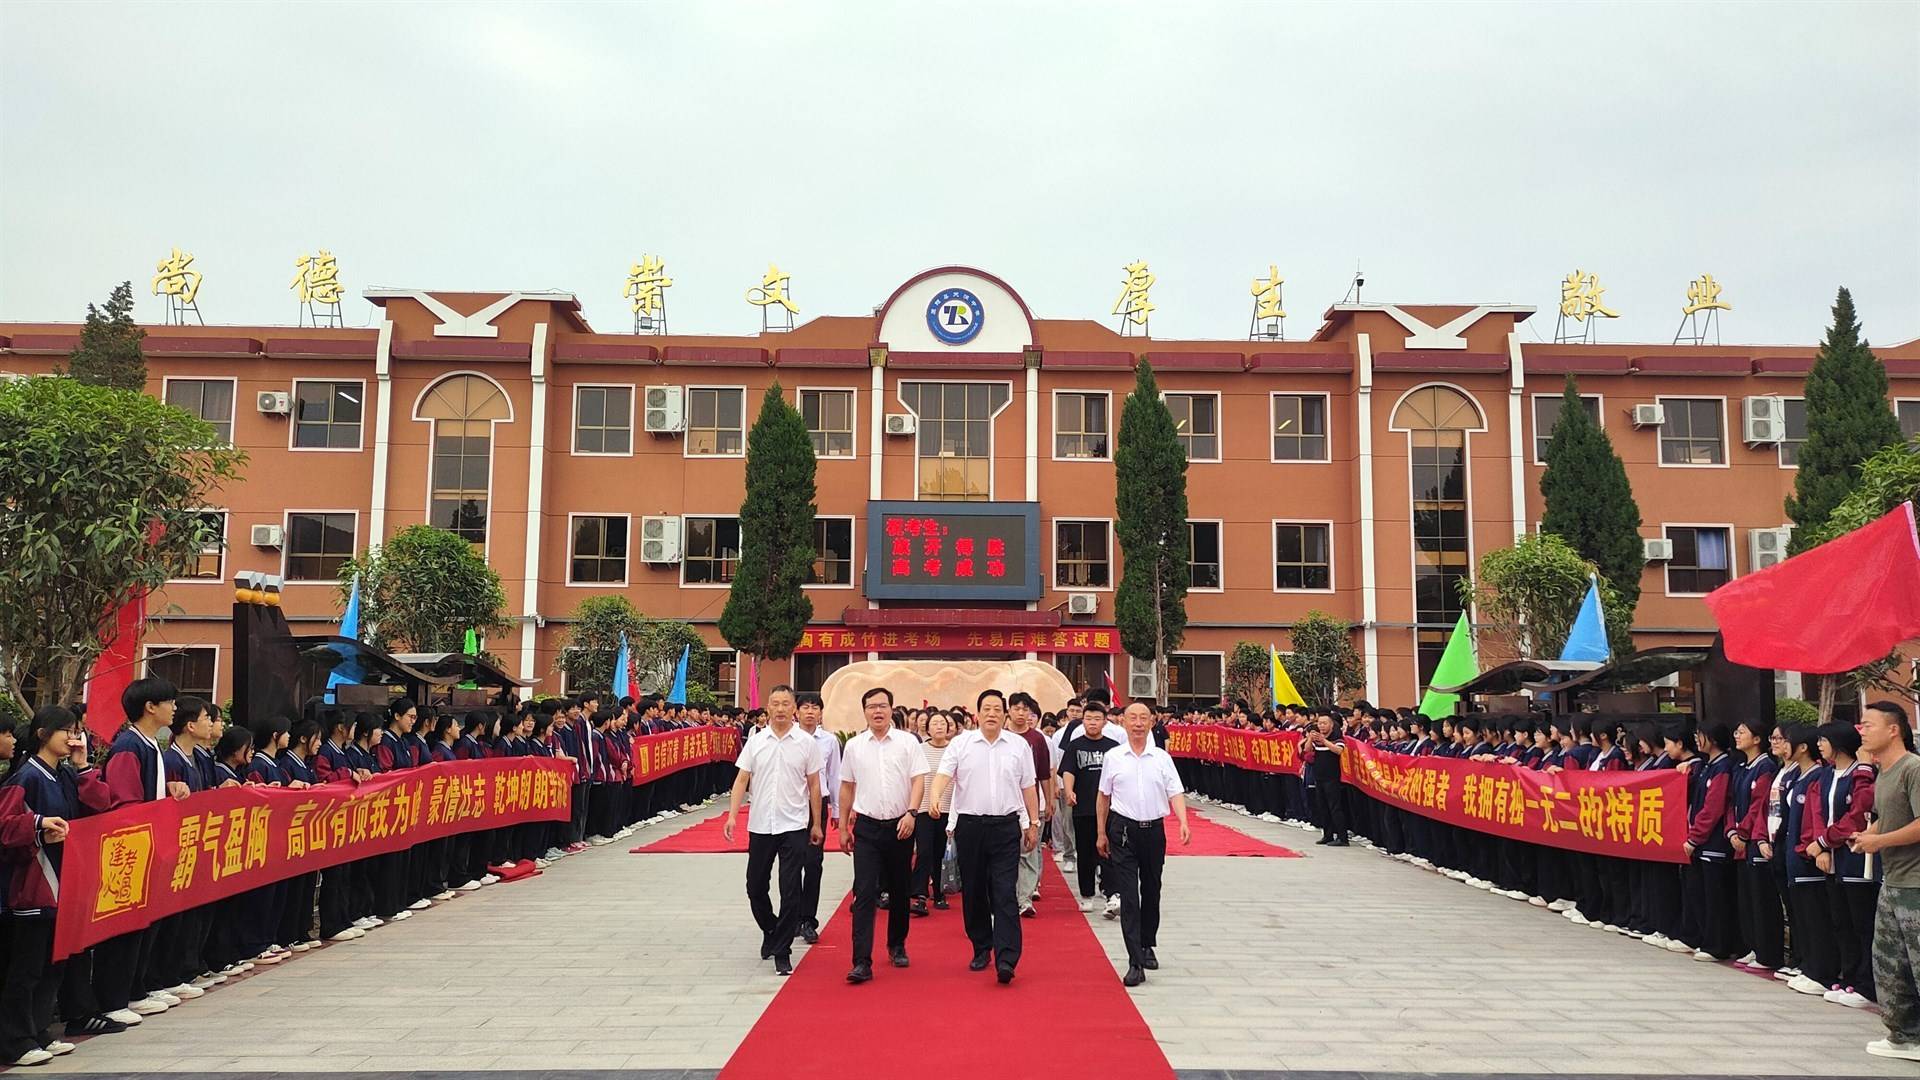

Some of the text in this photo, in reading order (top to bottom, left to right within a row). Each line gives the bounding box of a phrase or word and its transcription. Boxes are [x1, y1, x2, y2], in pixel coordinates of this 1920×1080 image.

[892, 558, 1005, 577] 高考成功
[967, 631, 1110, 648] 先易后难答试题
[654, 737, 680, 772] 自信沉着
[682, 731, 709, 761] 勇者无畏
[1251, 738, 1295, 767] 夺取胜利
[1462, 773, 1665, 846] 我拥有独一无二的特质
[170, 804, 272, 893] 霸气盈胸
[427, 773, 486, 826] 豪情壮志
